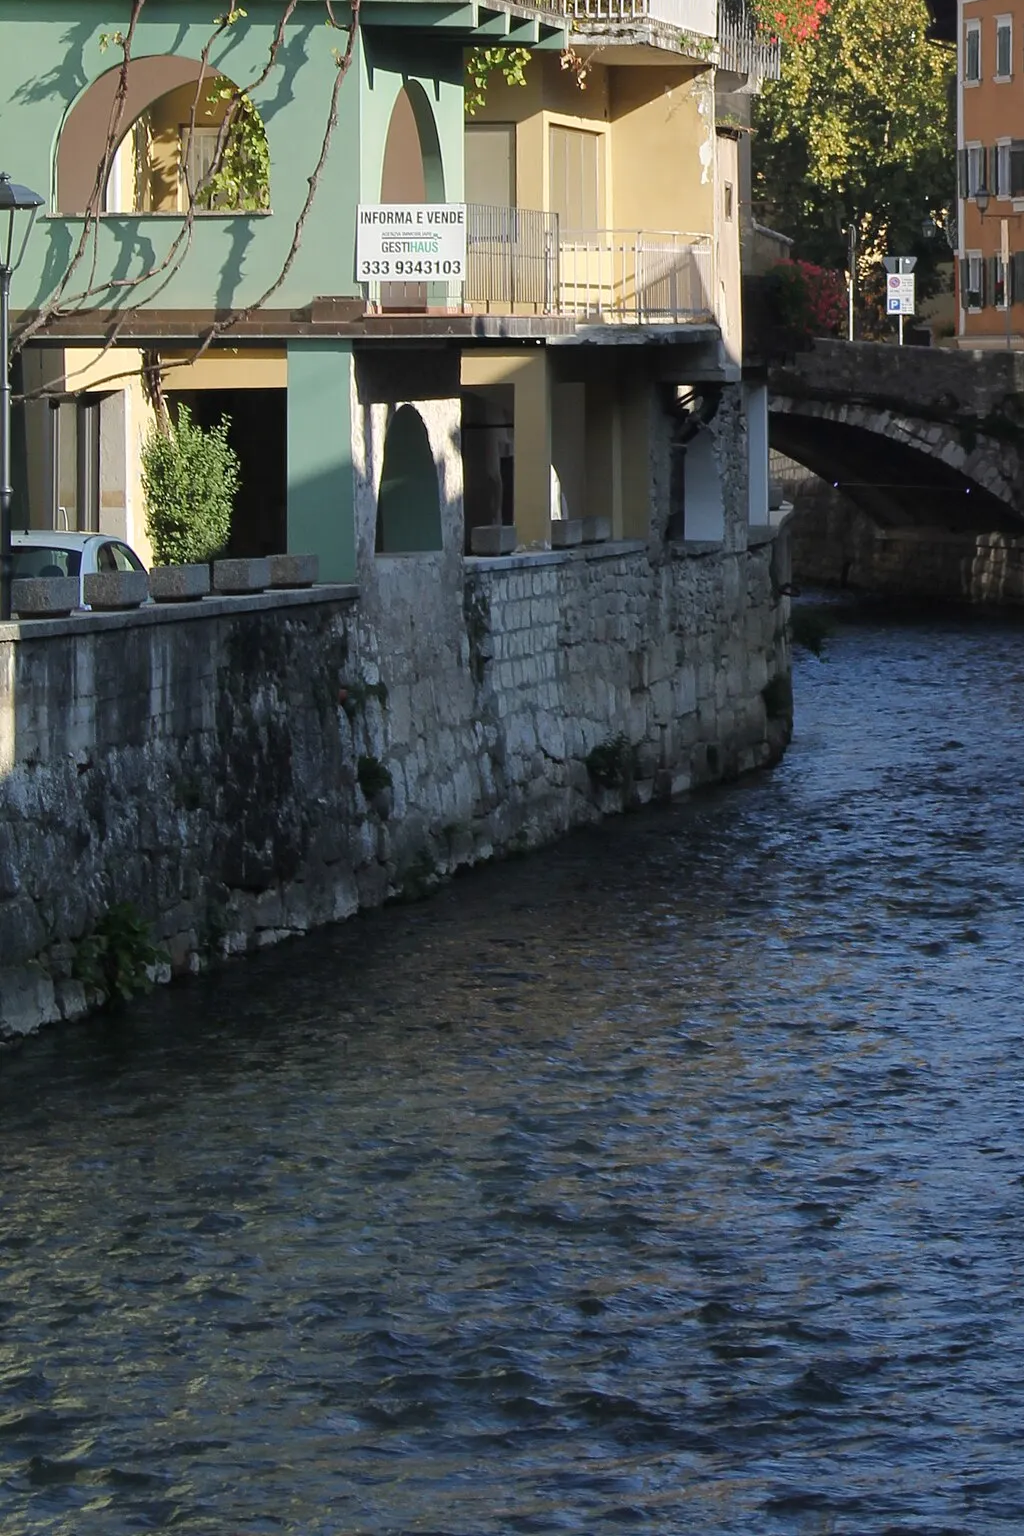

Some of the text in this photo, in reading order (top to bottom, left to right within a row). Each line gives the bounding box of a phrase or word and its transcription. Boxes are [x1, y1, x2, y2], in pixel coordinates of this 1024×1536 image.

[361, 211, 464, 224] INFORMA E VENDE
[381, 241, 439, 253] GESTIHAUS
[362, 261, 461, 275] 333 9343103
